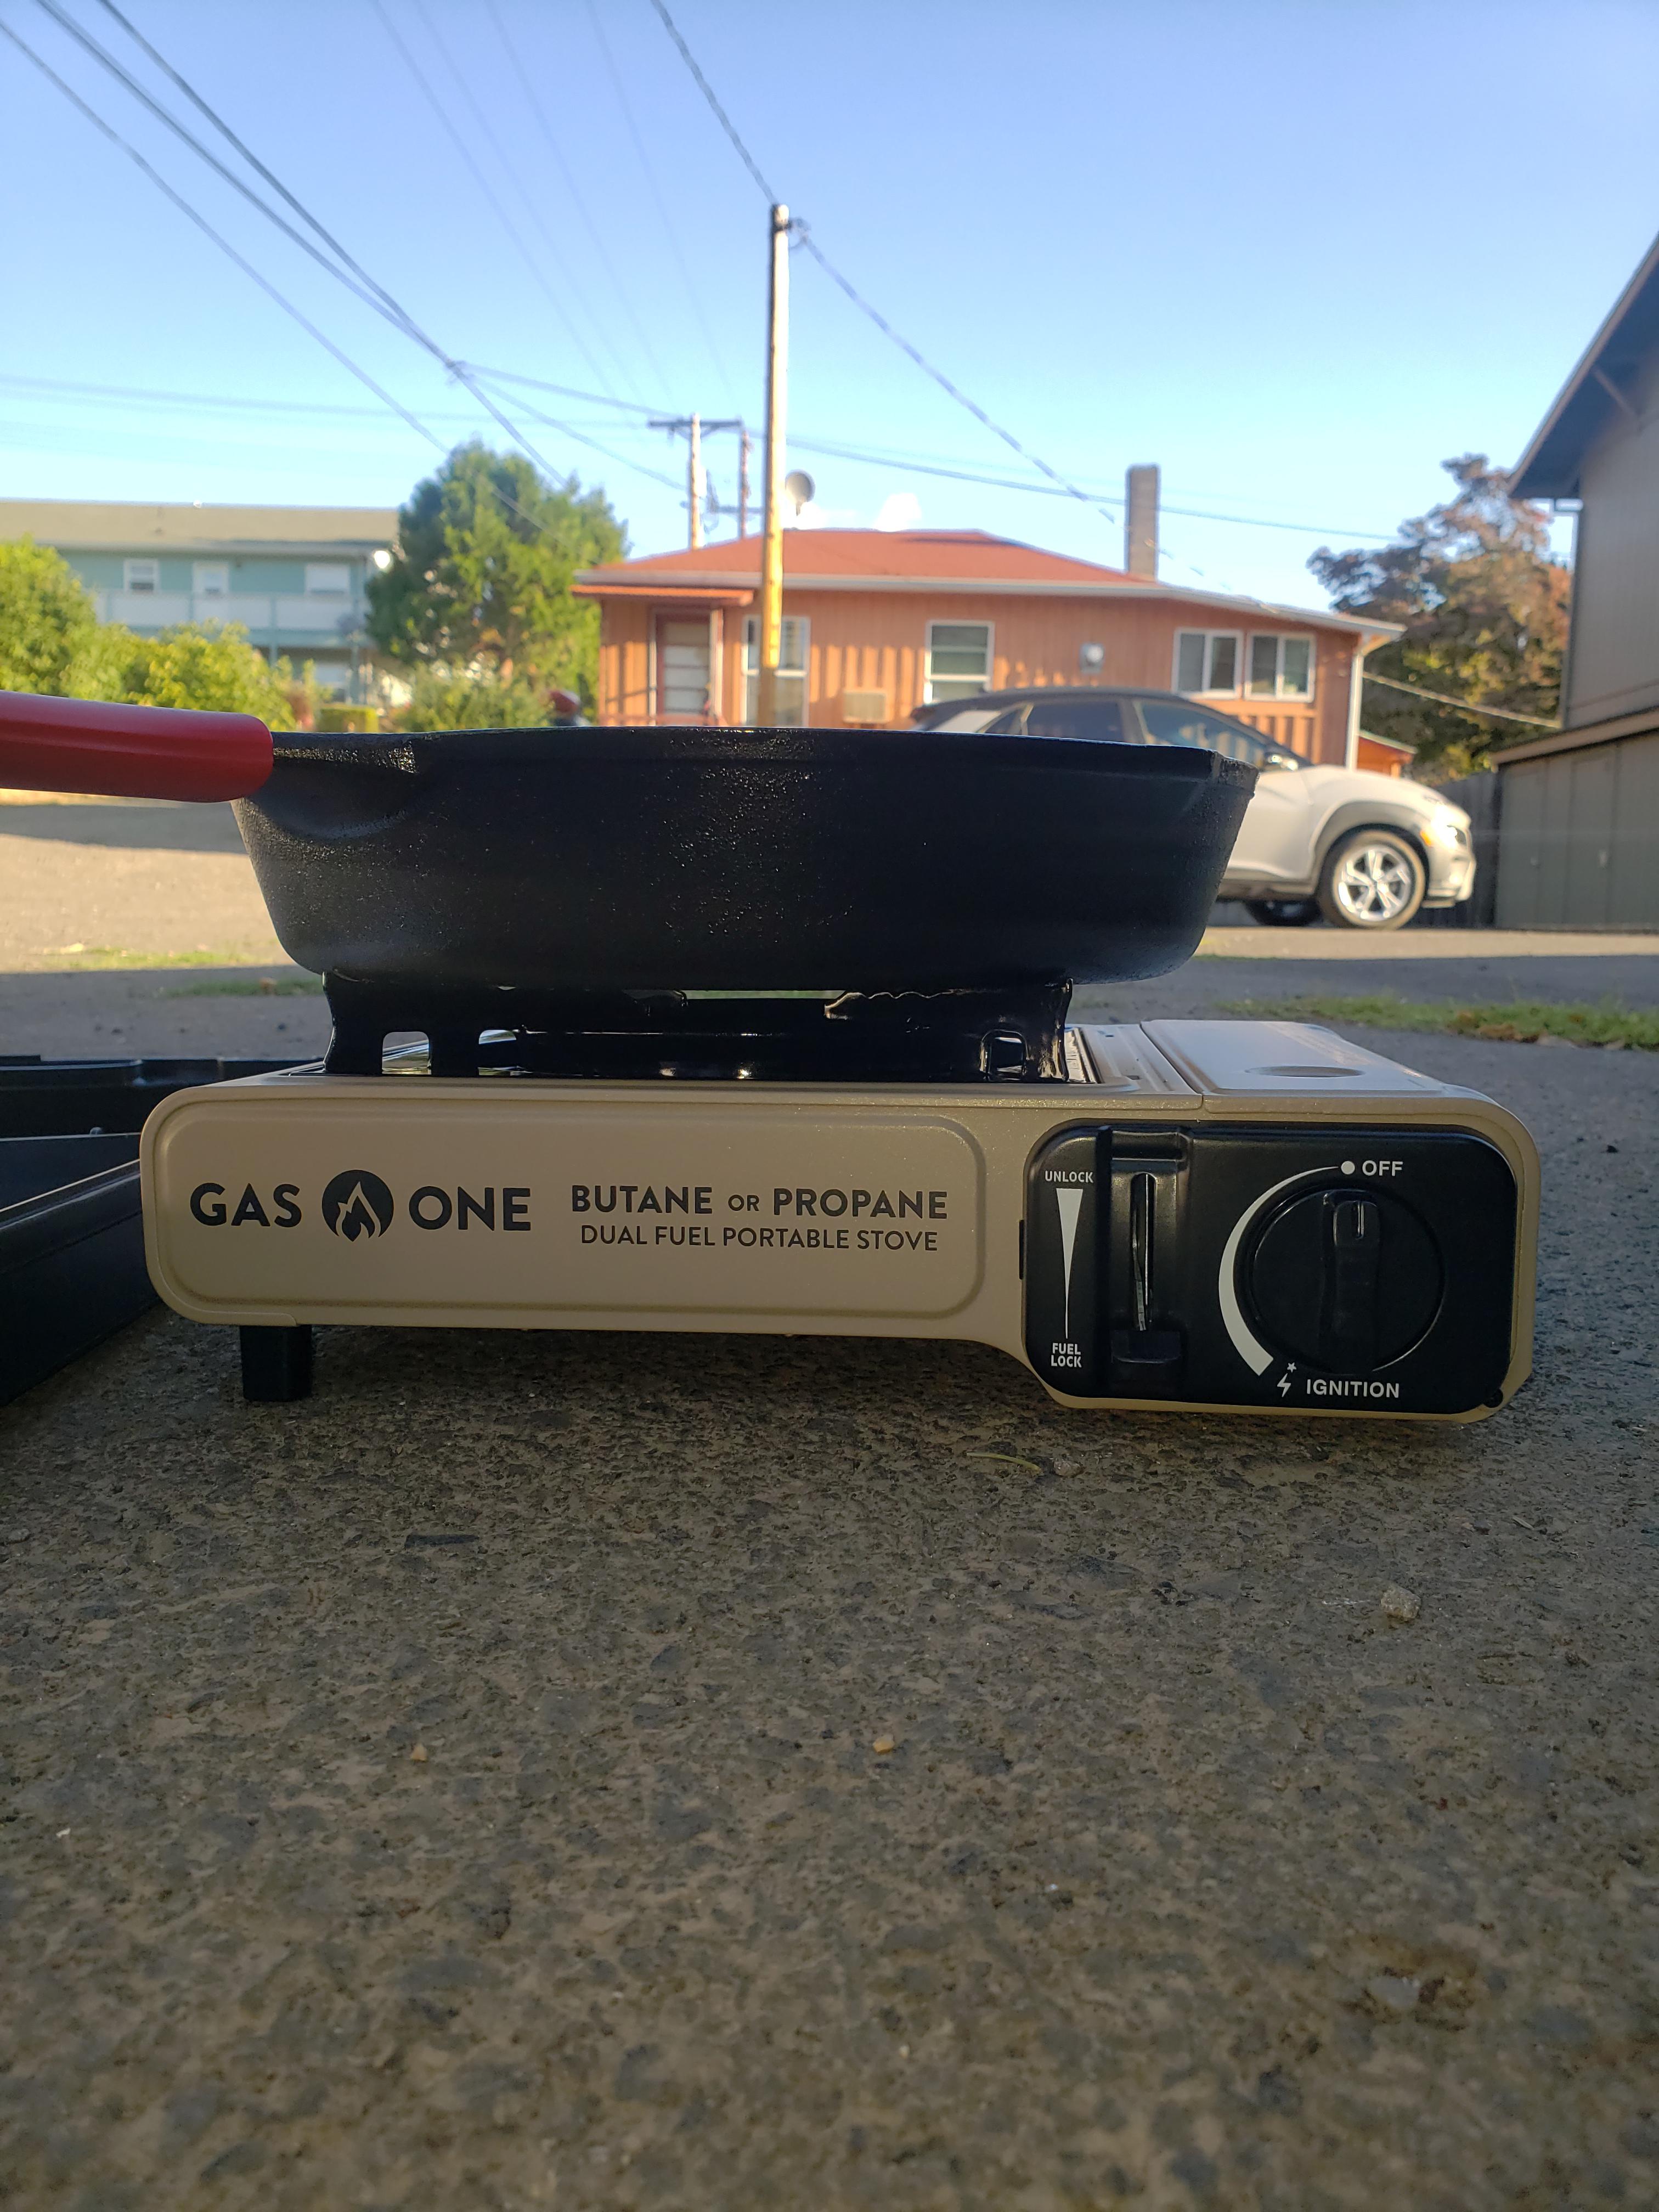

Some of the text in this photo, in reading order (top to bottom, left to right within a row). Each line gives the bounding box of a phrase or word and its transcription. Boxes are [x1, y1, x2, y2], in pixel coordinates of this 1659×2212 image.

[1045, 1170, 1093, 1183] UNLOCK
[1362, 1160, 1403, 1176] OFF
[189, 1182, 531, 1231] GAS ONE
[572, 1184, 947, 1219] BUTANE OR PROPANE
[581, 1224, 938, 1251] DUAL FUEL PORTABLE STOVE
[1052, 1342, 1081, 1355] FUEL
[1051, 1355, 1082, 1368] LOCK
[1306, 1379, 1400, 1398] IGNITION
